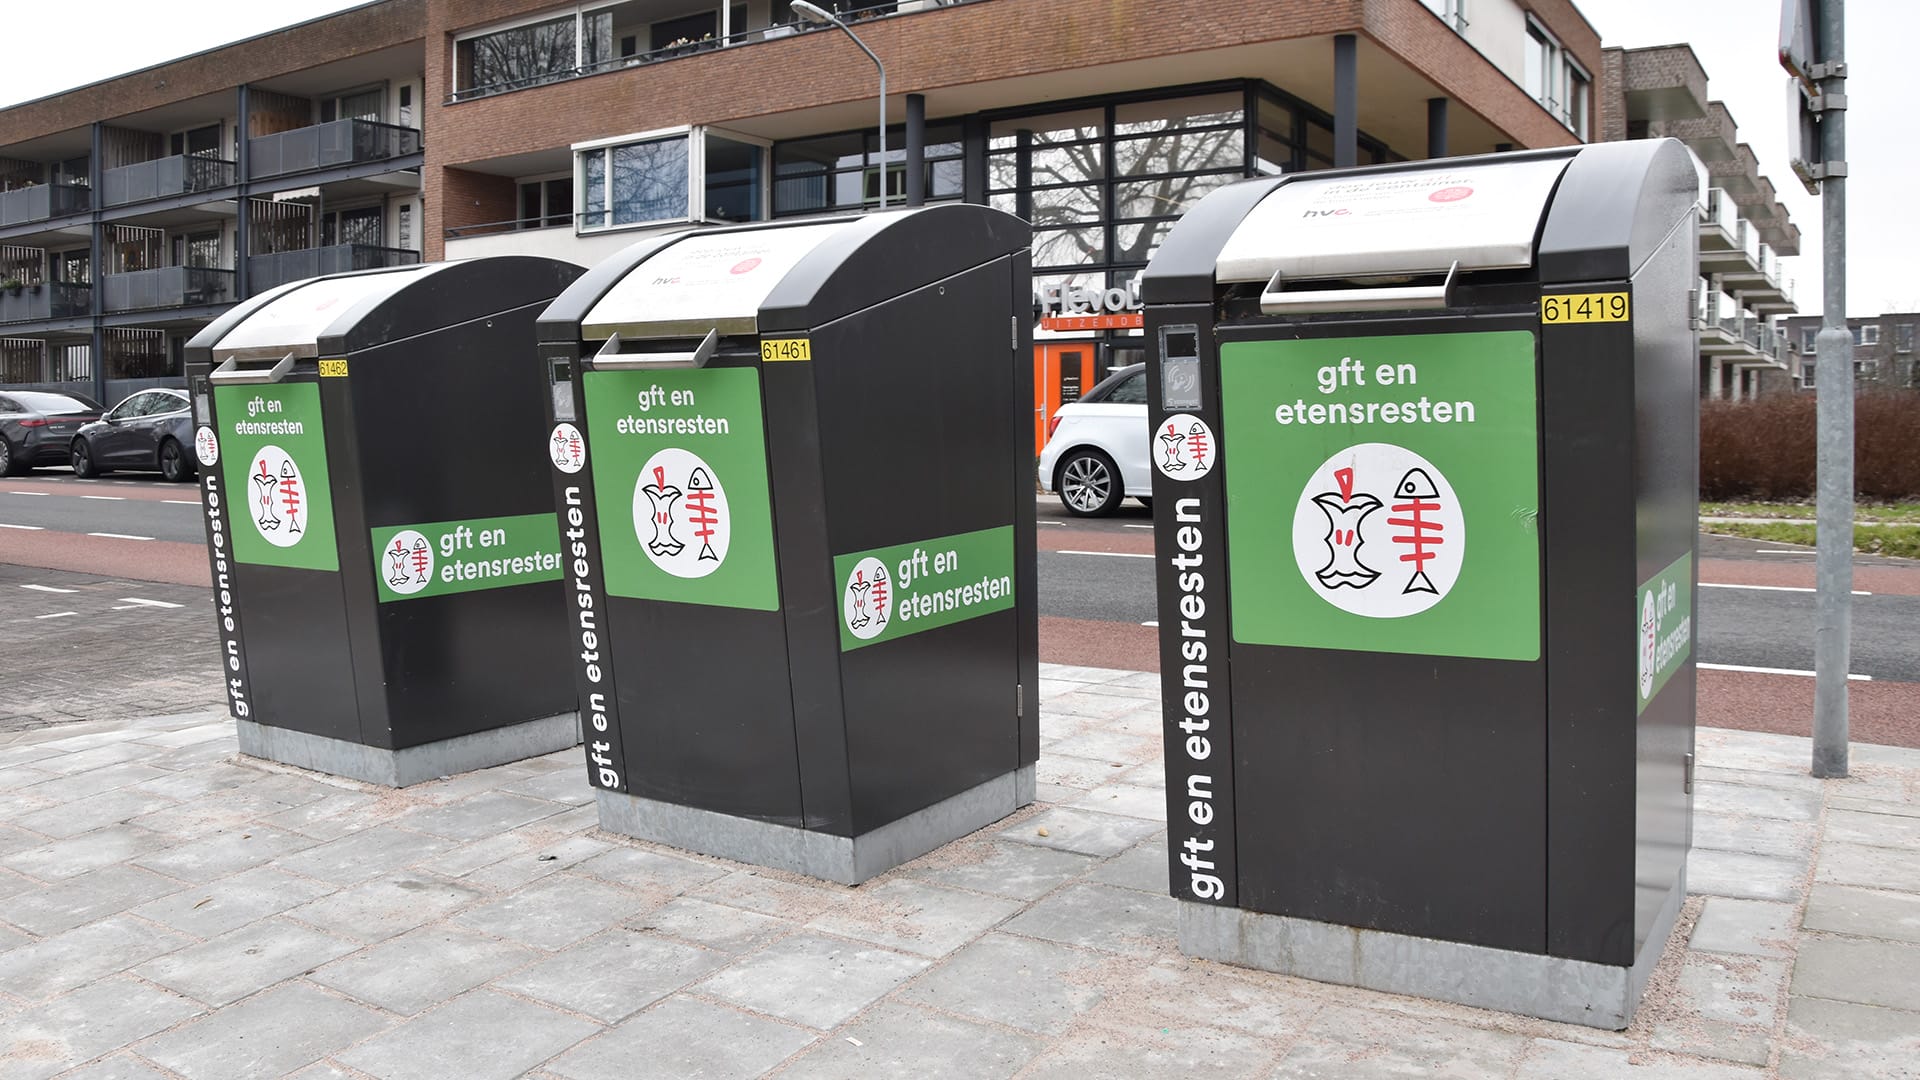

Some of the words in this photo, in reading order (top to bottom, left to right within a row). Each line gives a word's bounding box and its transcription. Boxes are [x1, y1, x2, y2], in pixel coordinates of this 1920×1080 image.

[1544, 296, 1627, 321] 61419
[320, 361, 347, 376] 61462
[763, 341, 809, 360] 61461
[1317, 356, 1366, 395] gft
[1375, 363, 1417, 386] en
[247, 396, 266, 418] gft
[267, 400, 283, 413] en
[638, 385, 667, 412] gft
[671, 389, 695, 406] en
[1275, 396, 1475, 425] etensresten
[235, 418, 304, 435] etensresten
[616, 414, 729, 435] etensresten
[206, 475, 235, 631] etensresten
[440, 525, 473, 557] gft
[479, 528, 506, 548] en
[565, 486, 602, 683] etensresten
[898, 548, 929, 589] gft
[934, 549, 958, 574] en
[899, 574, 1011, 622] etensresten
[1656, 579, 1668, 632] gft
[1668, 581, 1677, 613] en
[1172, 497, 1211, 760] etensresten
[1655, 614, 1691, 674] etensresten
[223, 640, 240, 671] en
[230, 678, 249, 717] gft
[590, 694, 607, 732] en
[591, 740, 619, 788] gft
[1188, 774, 1213, 825] en
[1180, 837, 1224, 900] gft
